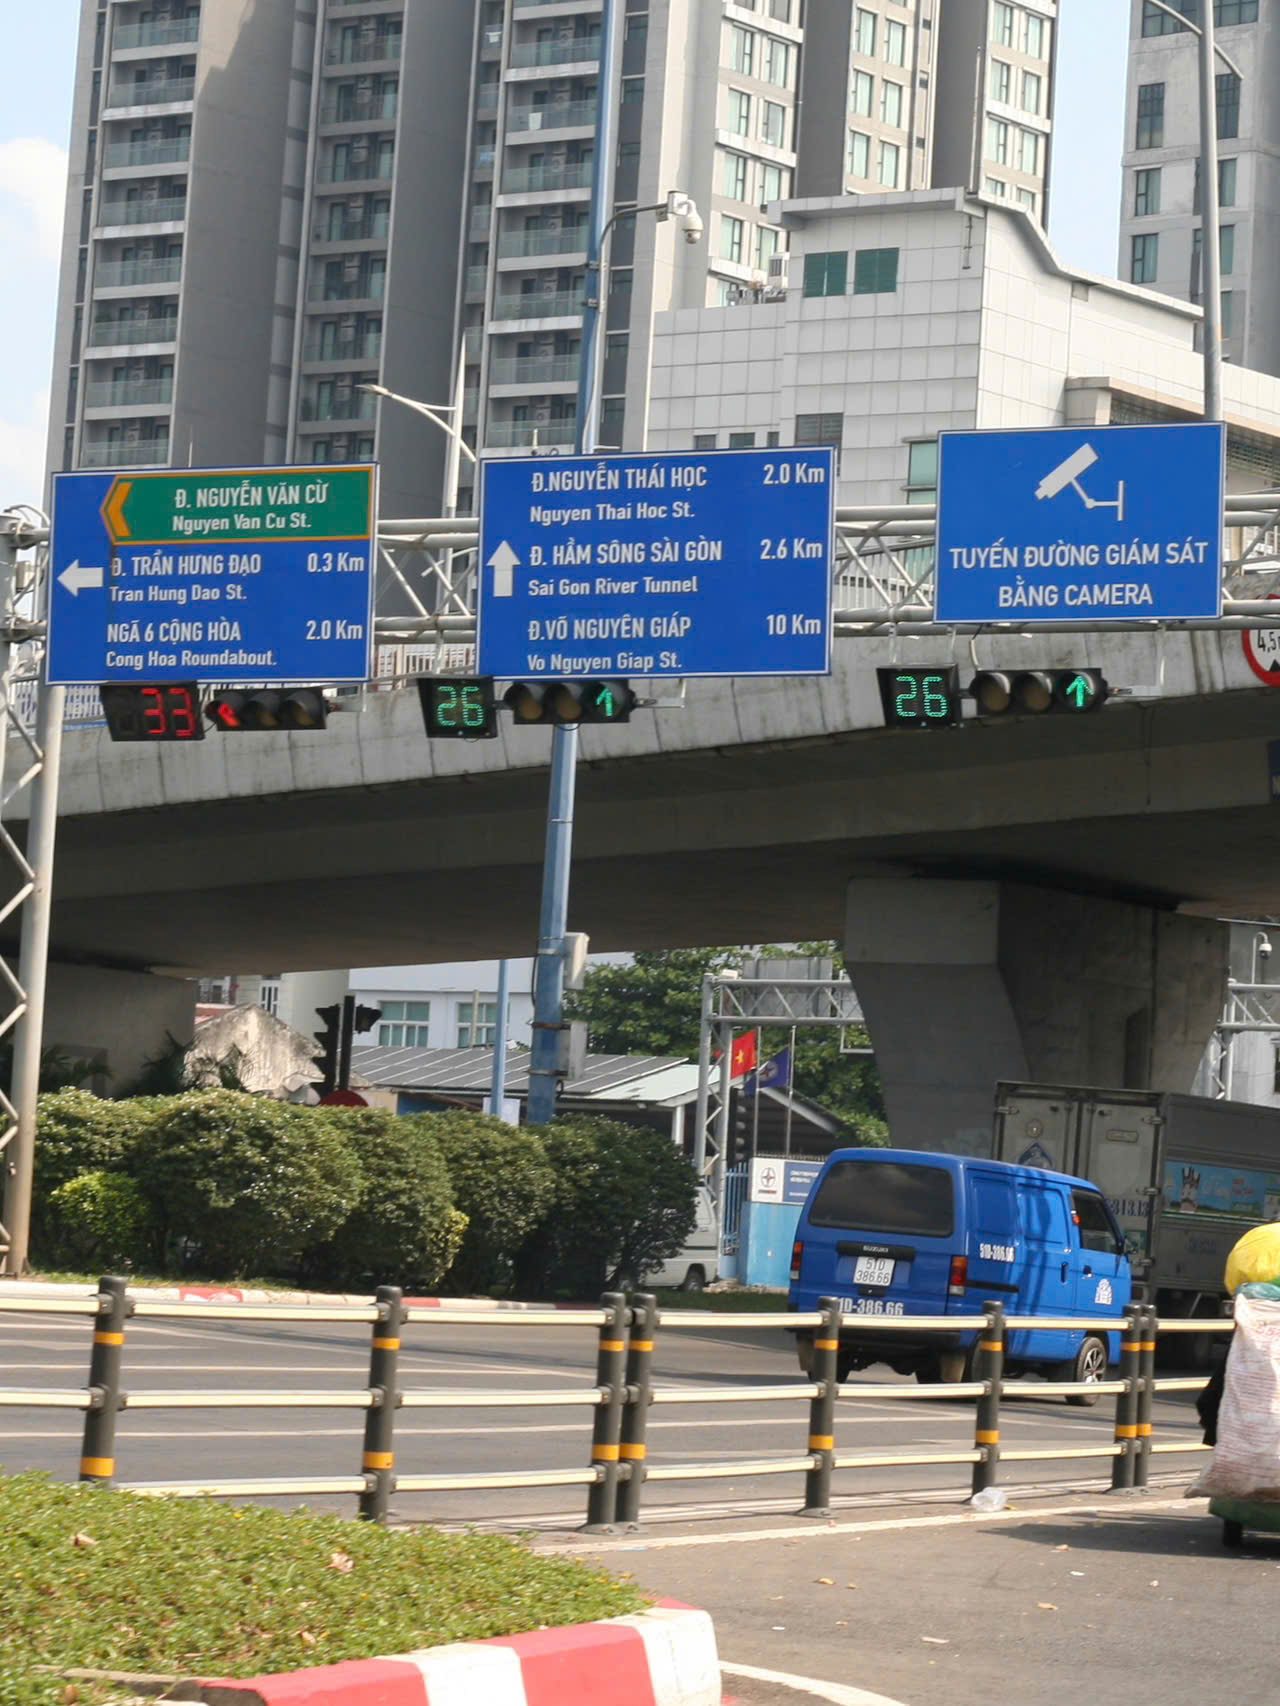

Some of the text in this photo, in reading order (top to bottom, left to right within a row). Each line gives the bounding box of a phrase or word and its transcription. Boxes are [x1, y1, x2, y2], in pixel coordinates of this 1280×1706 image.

[625, 463, 665, 489] THÁI
[671, 466, 708, 491] HỌC
[763, 463, 825, 485] 2.0 Km
[197, 480, 263, 509] NGUYỄN
[267, 482, 300, 506] VĂN
[305, 479, 330, 505] CỪ
[172, 512, 312, 535] Nguyen Van Cu St.
[530, 501, 695, 526] Nguyen Thai Hoc St.
[553, 536, 591, 566] HẦM
[597, 539, 646, 564] SÔNG
[651, 536, 680, 563] SÀI
[685, 534, 722, 562] GÒN
[760, 538, 823, 560] 2.6 Km
[950, 535, 1209, 570] TUYẾN ĐƯỜNG GIÁM SÁT
[131, 549, 173, 576] TRẦN
[228, 553, 262, 577] ĐẠO
[307, 552, 365, 573] 0.3 Km
[109, 584, 248, 605] Tran Hung Dao St.
[528, 576, 698, 596] Sai Gon River Tunnel
[998, 575, 1153, 608] BẰNG CAMERA
[107, 616, 242, 645] NGÃ 6 CỘNG HÒA
[306, 620, 363, 640] 2.0 Km
[574, 614, 644, 640] NGUYÊN
[650, 611, 692, 638] GIÁP
[766, 614, 822, 635] 10 Km
[105, 648, 277, 671] Cong Hoa Roundabout.
[527, 651, 682, 674] Vo Nguyen Giap St.
[437, 686, 484, 727] 26
[896, 676, 948, 718] 26
[141, 687, 196, 737] 33
[866, 1257, 886, 1271] 51D
[839, 1297, 904, 1316] 1D-386.66
